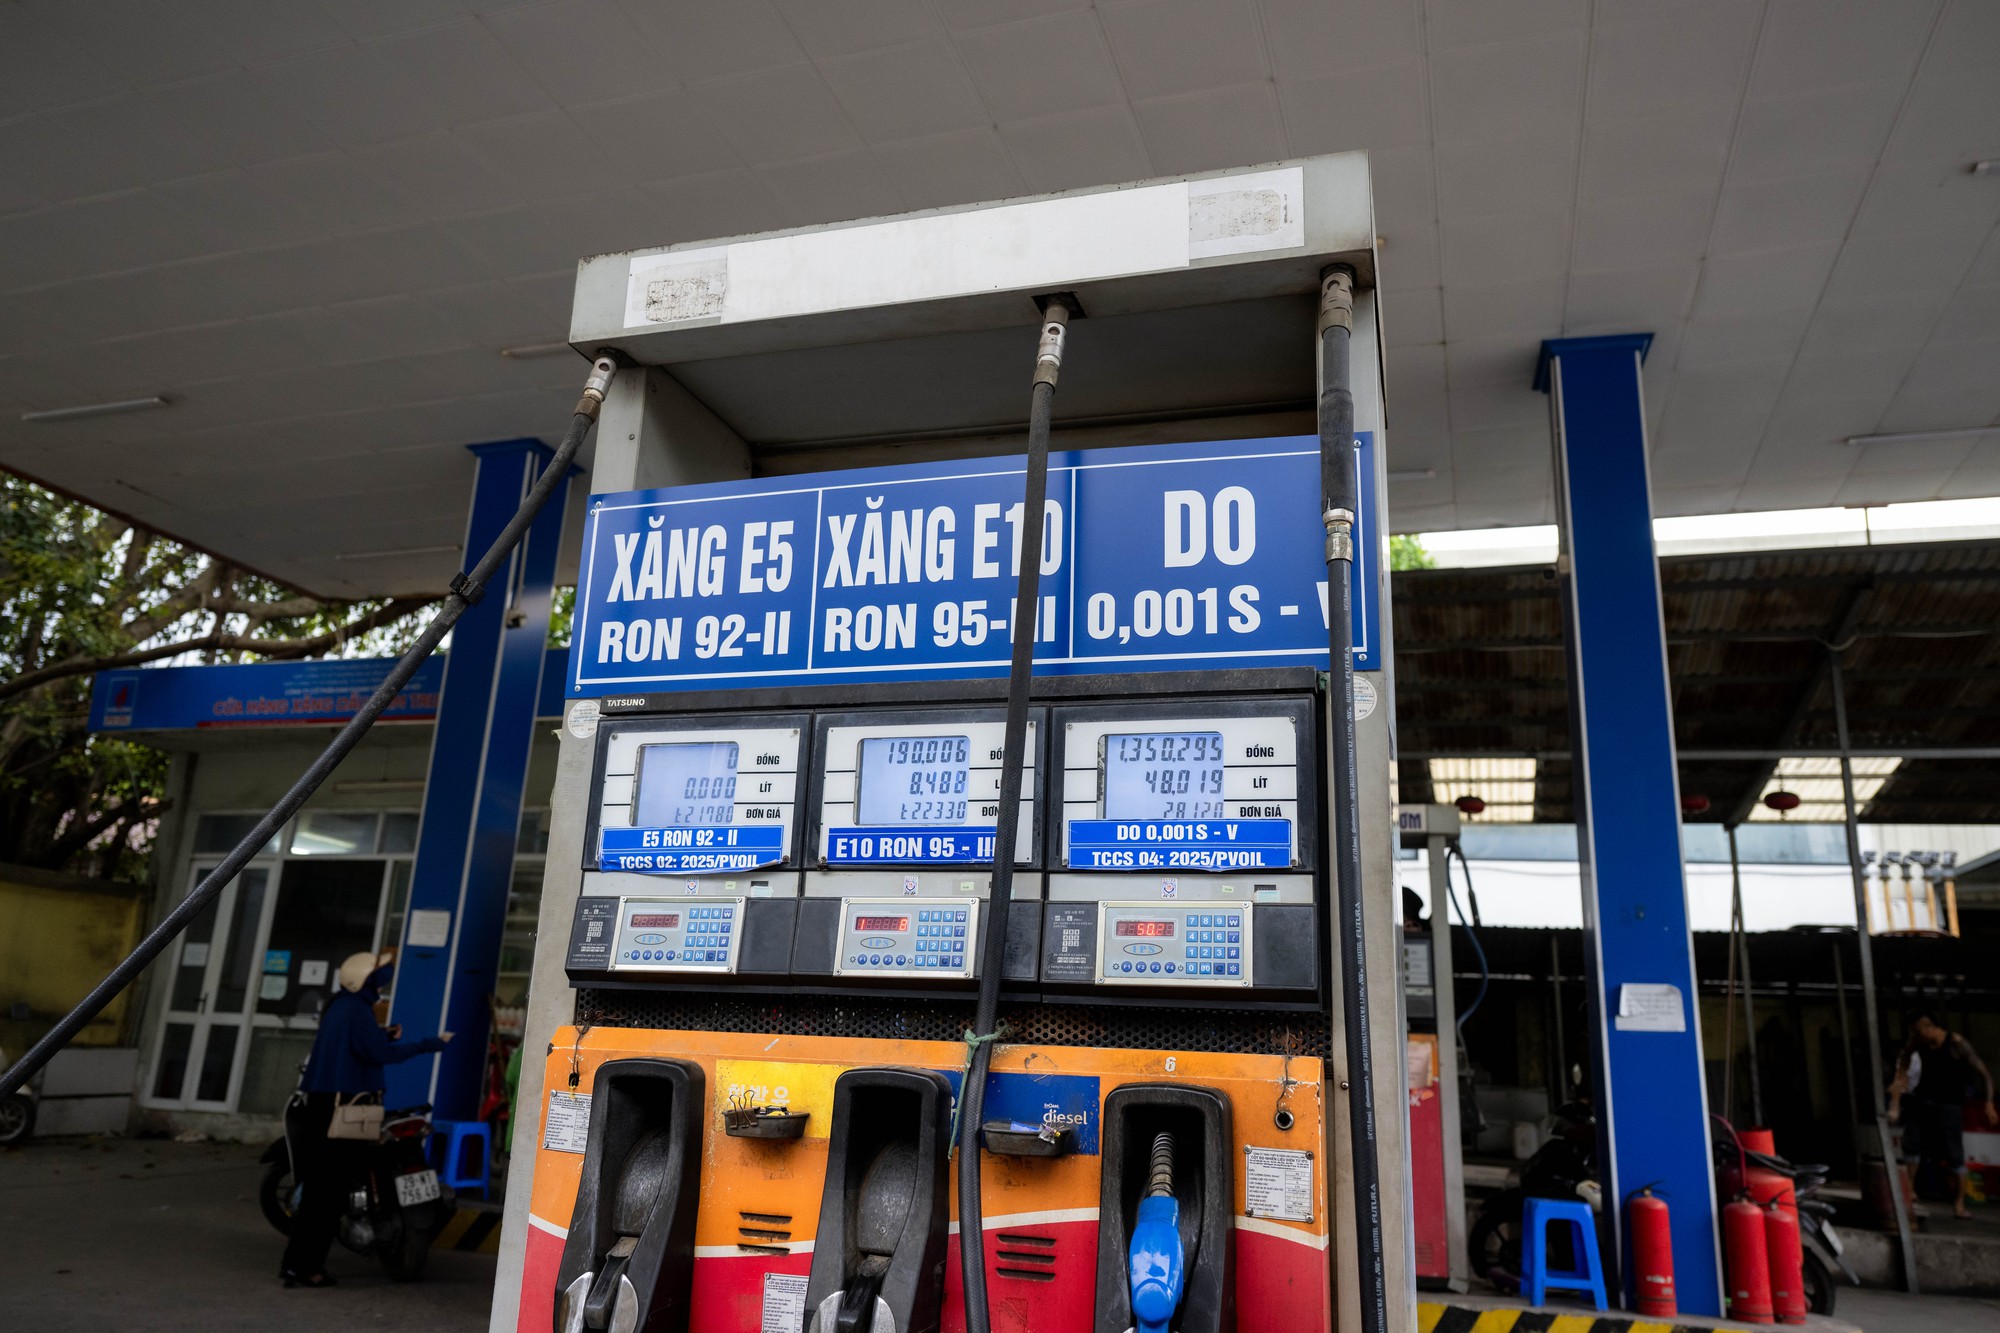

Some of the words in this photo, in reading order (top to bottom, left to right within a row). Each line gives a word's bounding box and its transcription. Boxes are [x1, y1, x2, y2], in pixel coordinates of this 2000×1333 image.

[1164, 487, 1255, 568] DO
[823, 496, 956, 588] XĂNG
[973, 500, 1063, 579] E10
[607, 515, 727, 602] XĂNG
[740, 521, 794, 594] E5
[1088, 585, 1261, 644] 0,001S
[598, 617, 682, 663] RON
[695, 611, 791, 658] 92-II
[824, 604, 917, 652] RON
[728, 748, 738, 769] 0
[1120, 736, 1222, 763] 1,350,295
[760, 782, 772, 793] LÍT
[1253, 778, 1268, 788] LÍT
[746, 807, 765, 819] ĐƠN
[767, 806, 780, 819] GIÁ
[1240, 807, 1261, 818] ĐƠN
[1265, 805, 1282, 818] GIÁ
[643, 830, 660, 846] E5
[663, 831, 692, 846] RON
[696, 830, 714, 845] 92
[1117, 825, 1140, 841] DO
[1146, 824, 1208, 842] 0,001S
[1227, 824, 1238, 840] V
[836, 839, 873, 858] E10
[879, 838, 922, 858] RON
[930, 838, 954, 857] 95
[619, 856, 652, 869] TCCS
[657, 856, 677, 869] 02:
[681, 855, 759, 869] 2025/PVOIL
[1092, 852, 1133, 866] TCCS
[1139, 852, 1164, 866] 04:
[1170, 852, 1265, 866] 2025/PVOIL
[1165, 1057, 1176, 1072] 6
[1043, 1110, 1087, 1124] diesel
[1370, 1182, 1378, 1224] FUTURA
